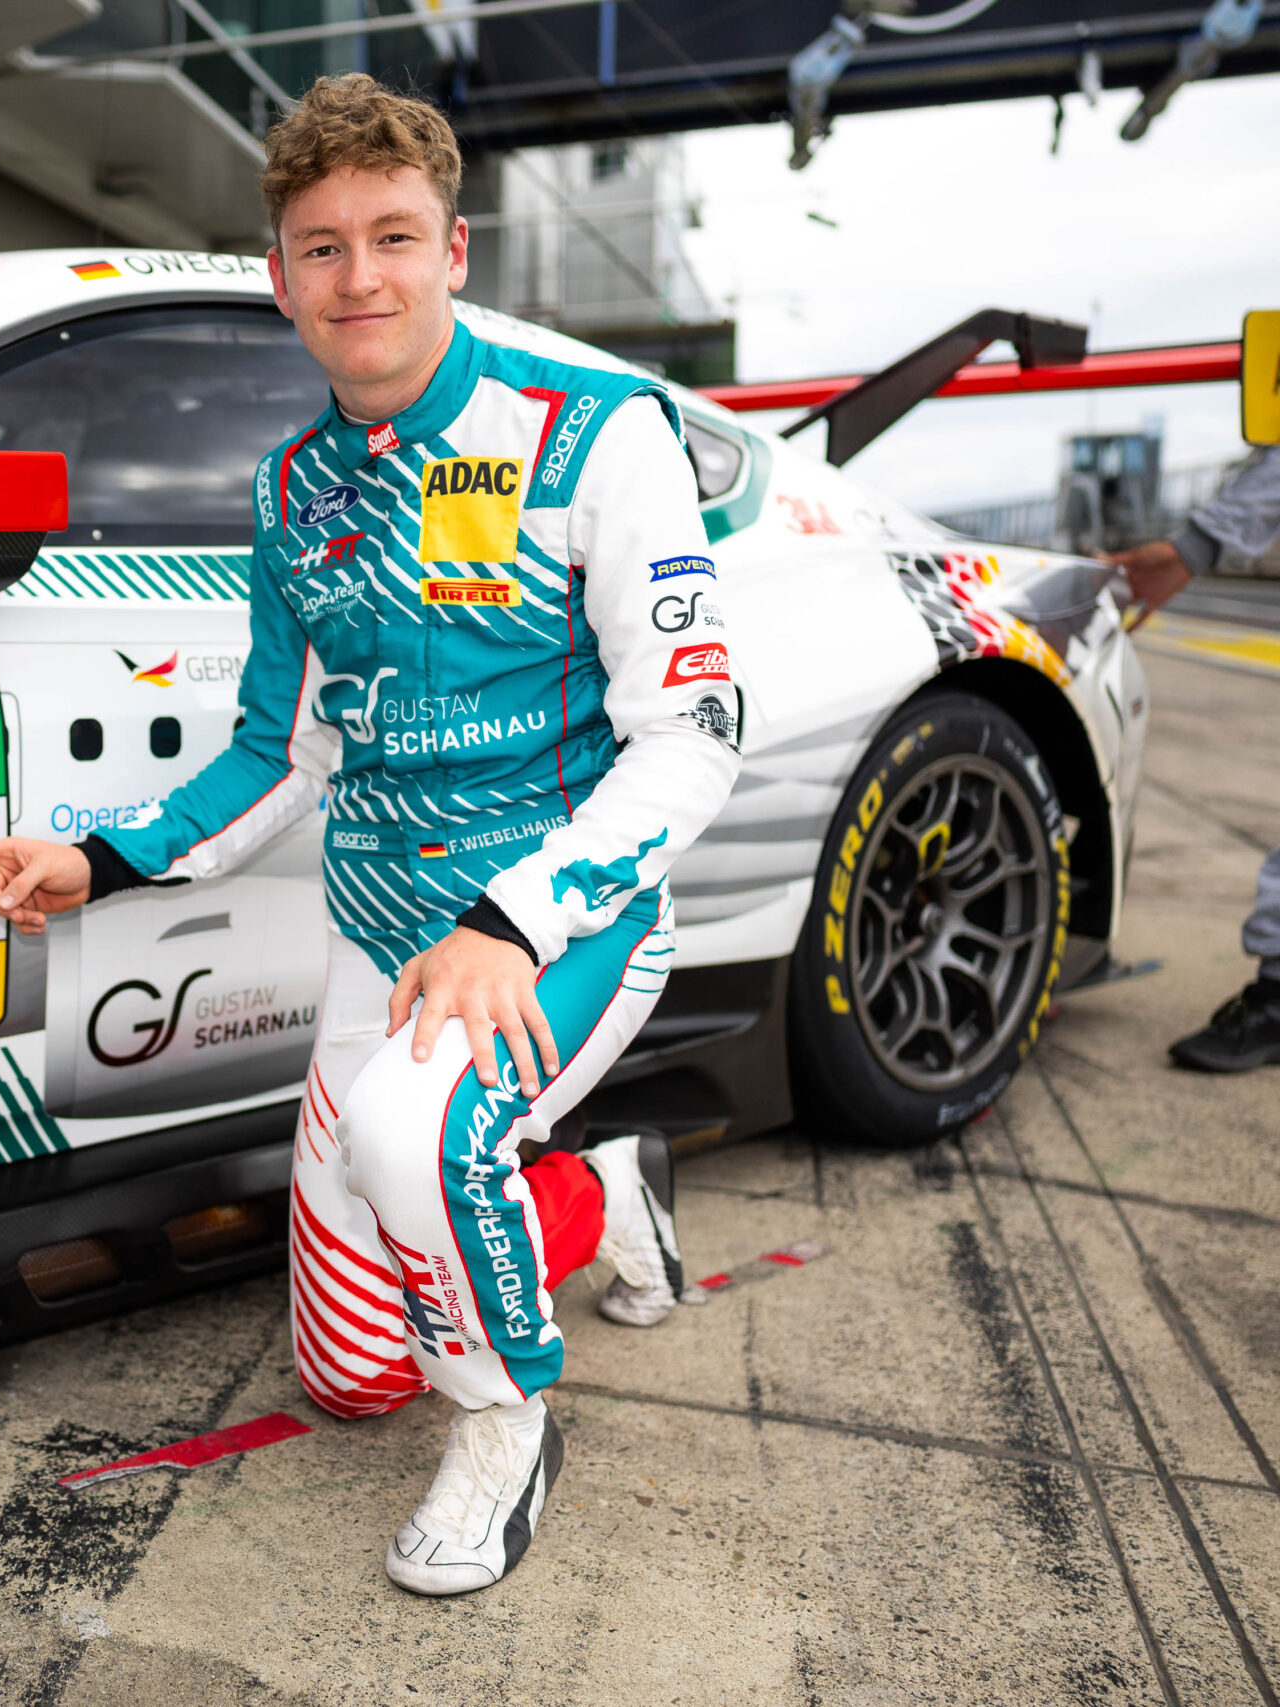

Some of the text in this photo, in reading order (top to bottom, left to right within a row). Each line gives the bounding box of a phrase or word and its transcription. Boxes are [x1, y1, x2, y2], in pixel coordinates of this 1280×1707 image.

[124, 254, 262, 275] OWEGA
[368, 423, 397, 453] Sport
[542, 395, 600, 488] sparco
[426, 462, 518, 498] ADAC
[308, 490, 348, 523] Ford
[334, 580, 366, 600] Team
[428, 582, 510, 603] PIRELLI
[383, 690, 481, 723] GUSTAV
[384, 711, 546, 755] SCHARNAU
[51, 797, 156, 838] Opera
[333, 831, 380, 849] sparco
[825, 779, 885, 1015] P ZERO
[195, 985, 279, 1020] GUSTAV
[194, 1005, 318, 1048] SCHARNAU
[431, 1255, 469, 1333] RACING TEAM
